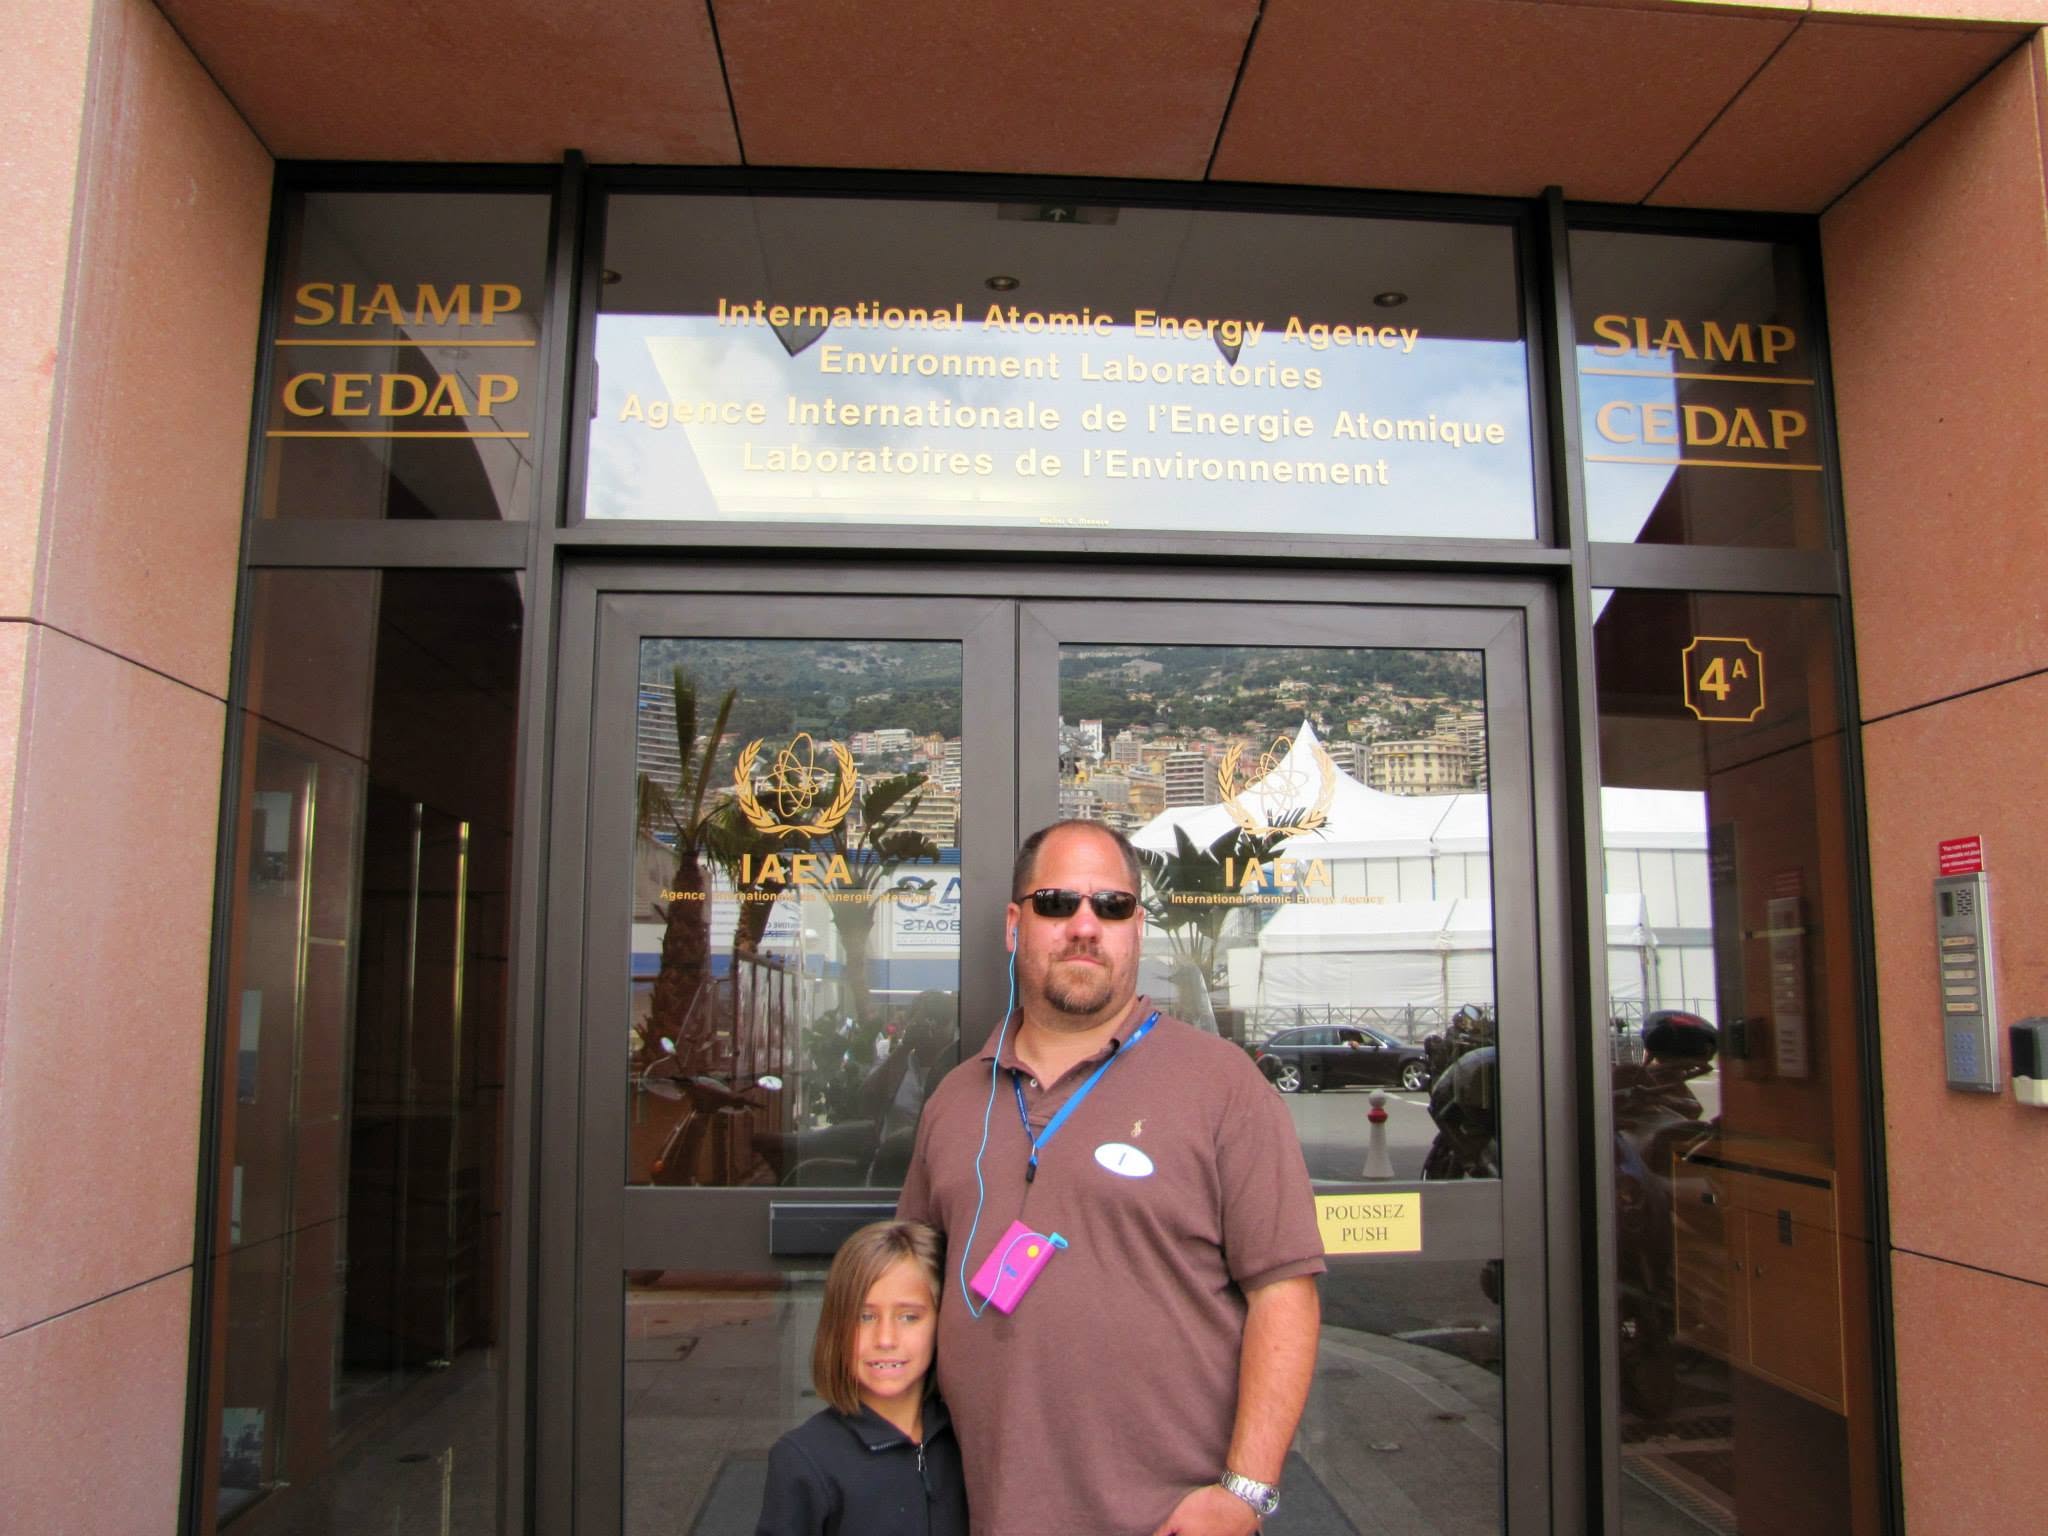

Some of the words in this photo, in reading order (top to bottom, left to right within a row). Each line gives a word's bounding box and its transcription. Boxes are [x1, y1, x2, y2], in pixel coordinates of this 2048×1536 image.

[294, 282, 522, 326] SIAMP
[717, 298, 964, 331] International
[982, 304, 1114, 336] Atomic
[1134, 309, 1265, 348] Energy
[1283, 316, 1419, 354] Agency
[1592, 314, 1796, 364] SIAMP
[819, 345, 1061, 380] Environment
[1081, 352, 1323, 390] Laboratories
[282, 372, 519, 417] CEDAP
[618, 393, 767, 430] Agence
[787, 396, 1061, 431] Internationale
[1081, 403, 1127, 432] de
[1332, 410, 1506, 449] Atomique
[1596, 399, 1808, 449] CEDAP
[742, 442, 994, 476] Laboratoires
[1015, 447, 1062, 477] de
[741, 852, 854, 885] IAEA
[1225, 856, 1333, 888] IAEA
[660, 889, 706, 902] Agence
[1171, 893, 1246, 904] International
[1325, 1204, 1405, 1221] POUSSEZ
[1341, 1227, 1388, 1242] PUSH
